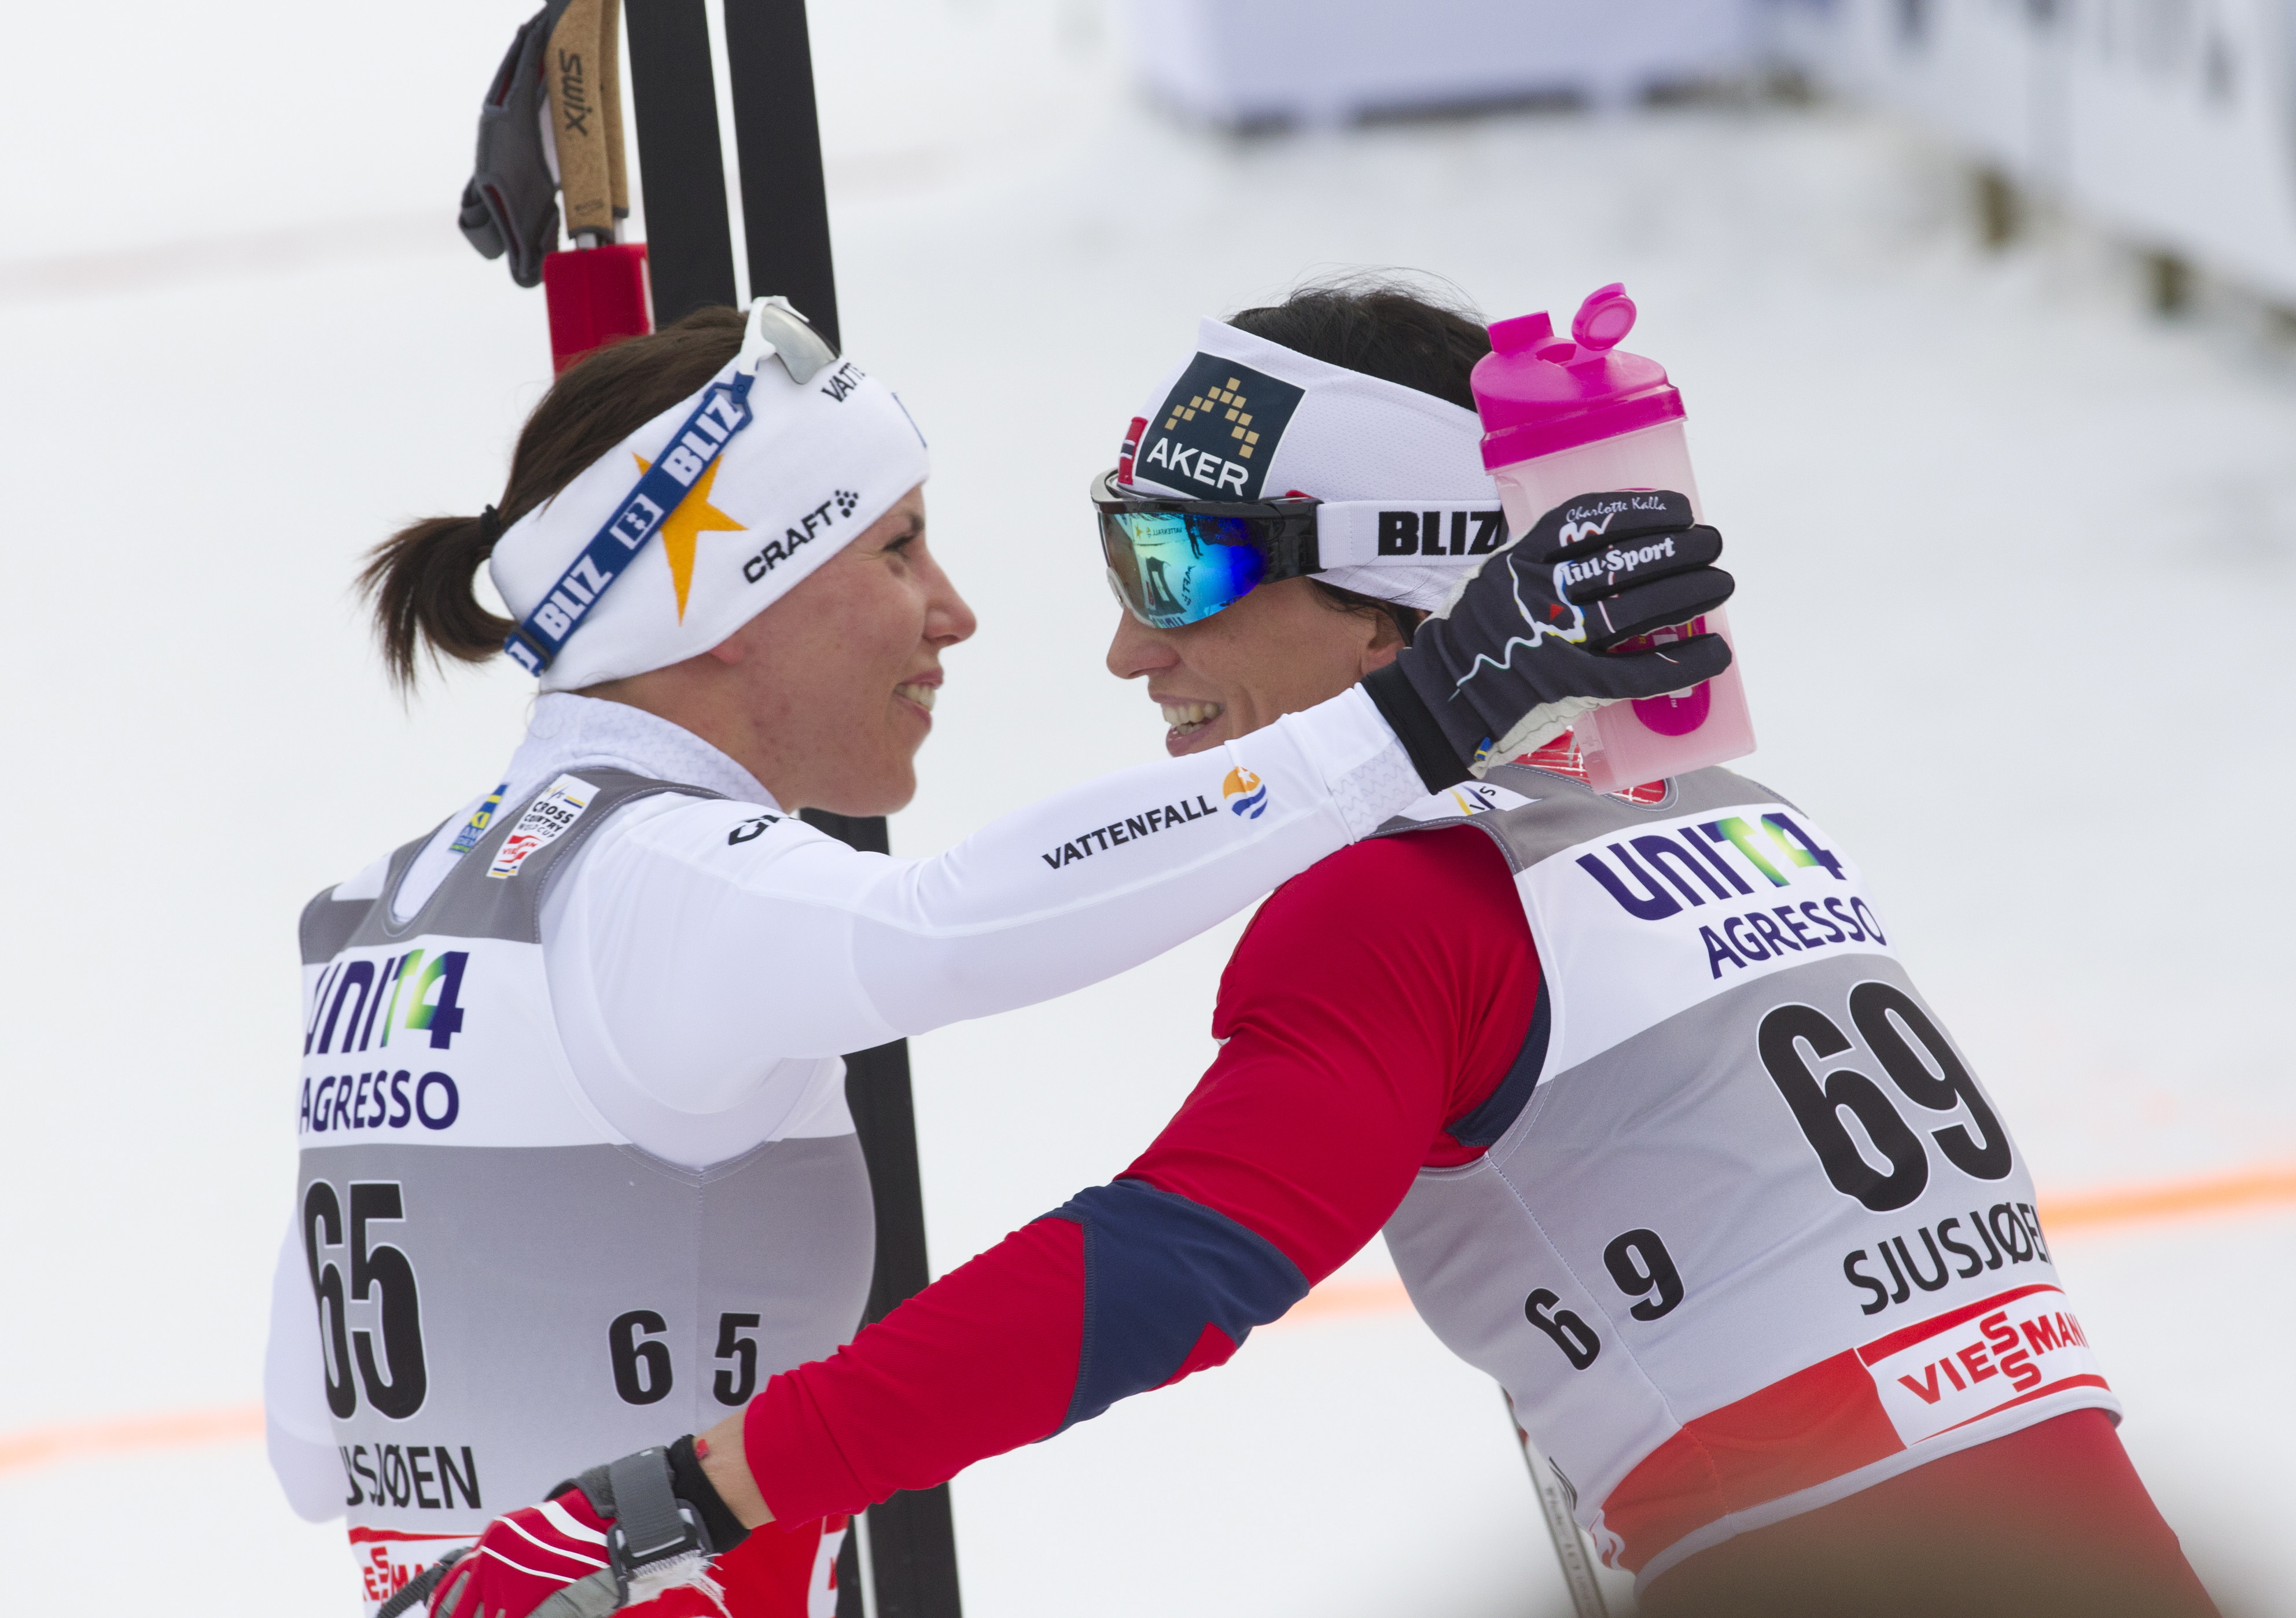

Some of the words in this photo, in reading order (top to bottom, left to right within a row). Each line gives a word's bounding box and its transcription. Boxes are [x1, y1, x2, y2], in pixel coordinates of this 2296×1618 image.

[661, 390, 745, 487] BLIZ
[1146, 437, 1249, 497] AKER
[742, 499, 832, 583] CRAFT
[1378, 511, 1504, 556] BLIZ
[1566, 501, 1628, 523] Charlotte
[1632, 497, 1666, 510] Kalla
[533, 555, 613, 641] BLIZ
[533, 801, 574, 823] CROSS
[1042, 795, 1218, 869] VATTENFALL
[1575, 812, 1847, 920] UNIT4
[1699, 896, 1886, 980] AGRESSO
[299, 1070, 459, 1135] AGRESSO
[1757, 981, 2012, 1212] 69
[304, 1181, 427, 1420] 65
[1525, 1288, 1600, 1370] 6
[1603, 1228, 1684, 1321] 9
[1842, 1201, 2052, 1315] SJUSJØE
[609, 1310, 674, 1406] 6
[713, 1313, 760, 1406] 5
[1897, 1310, 2089, 1406] VIESSMAN
